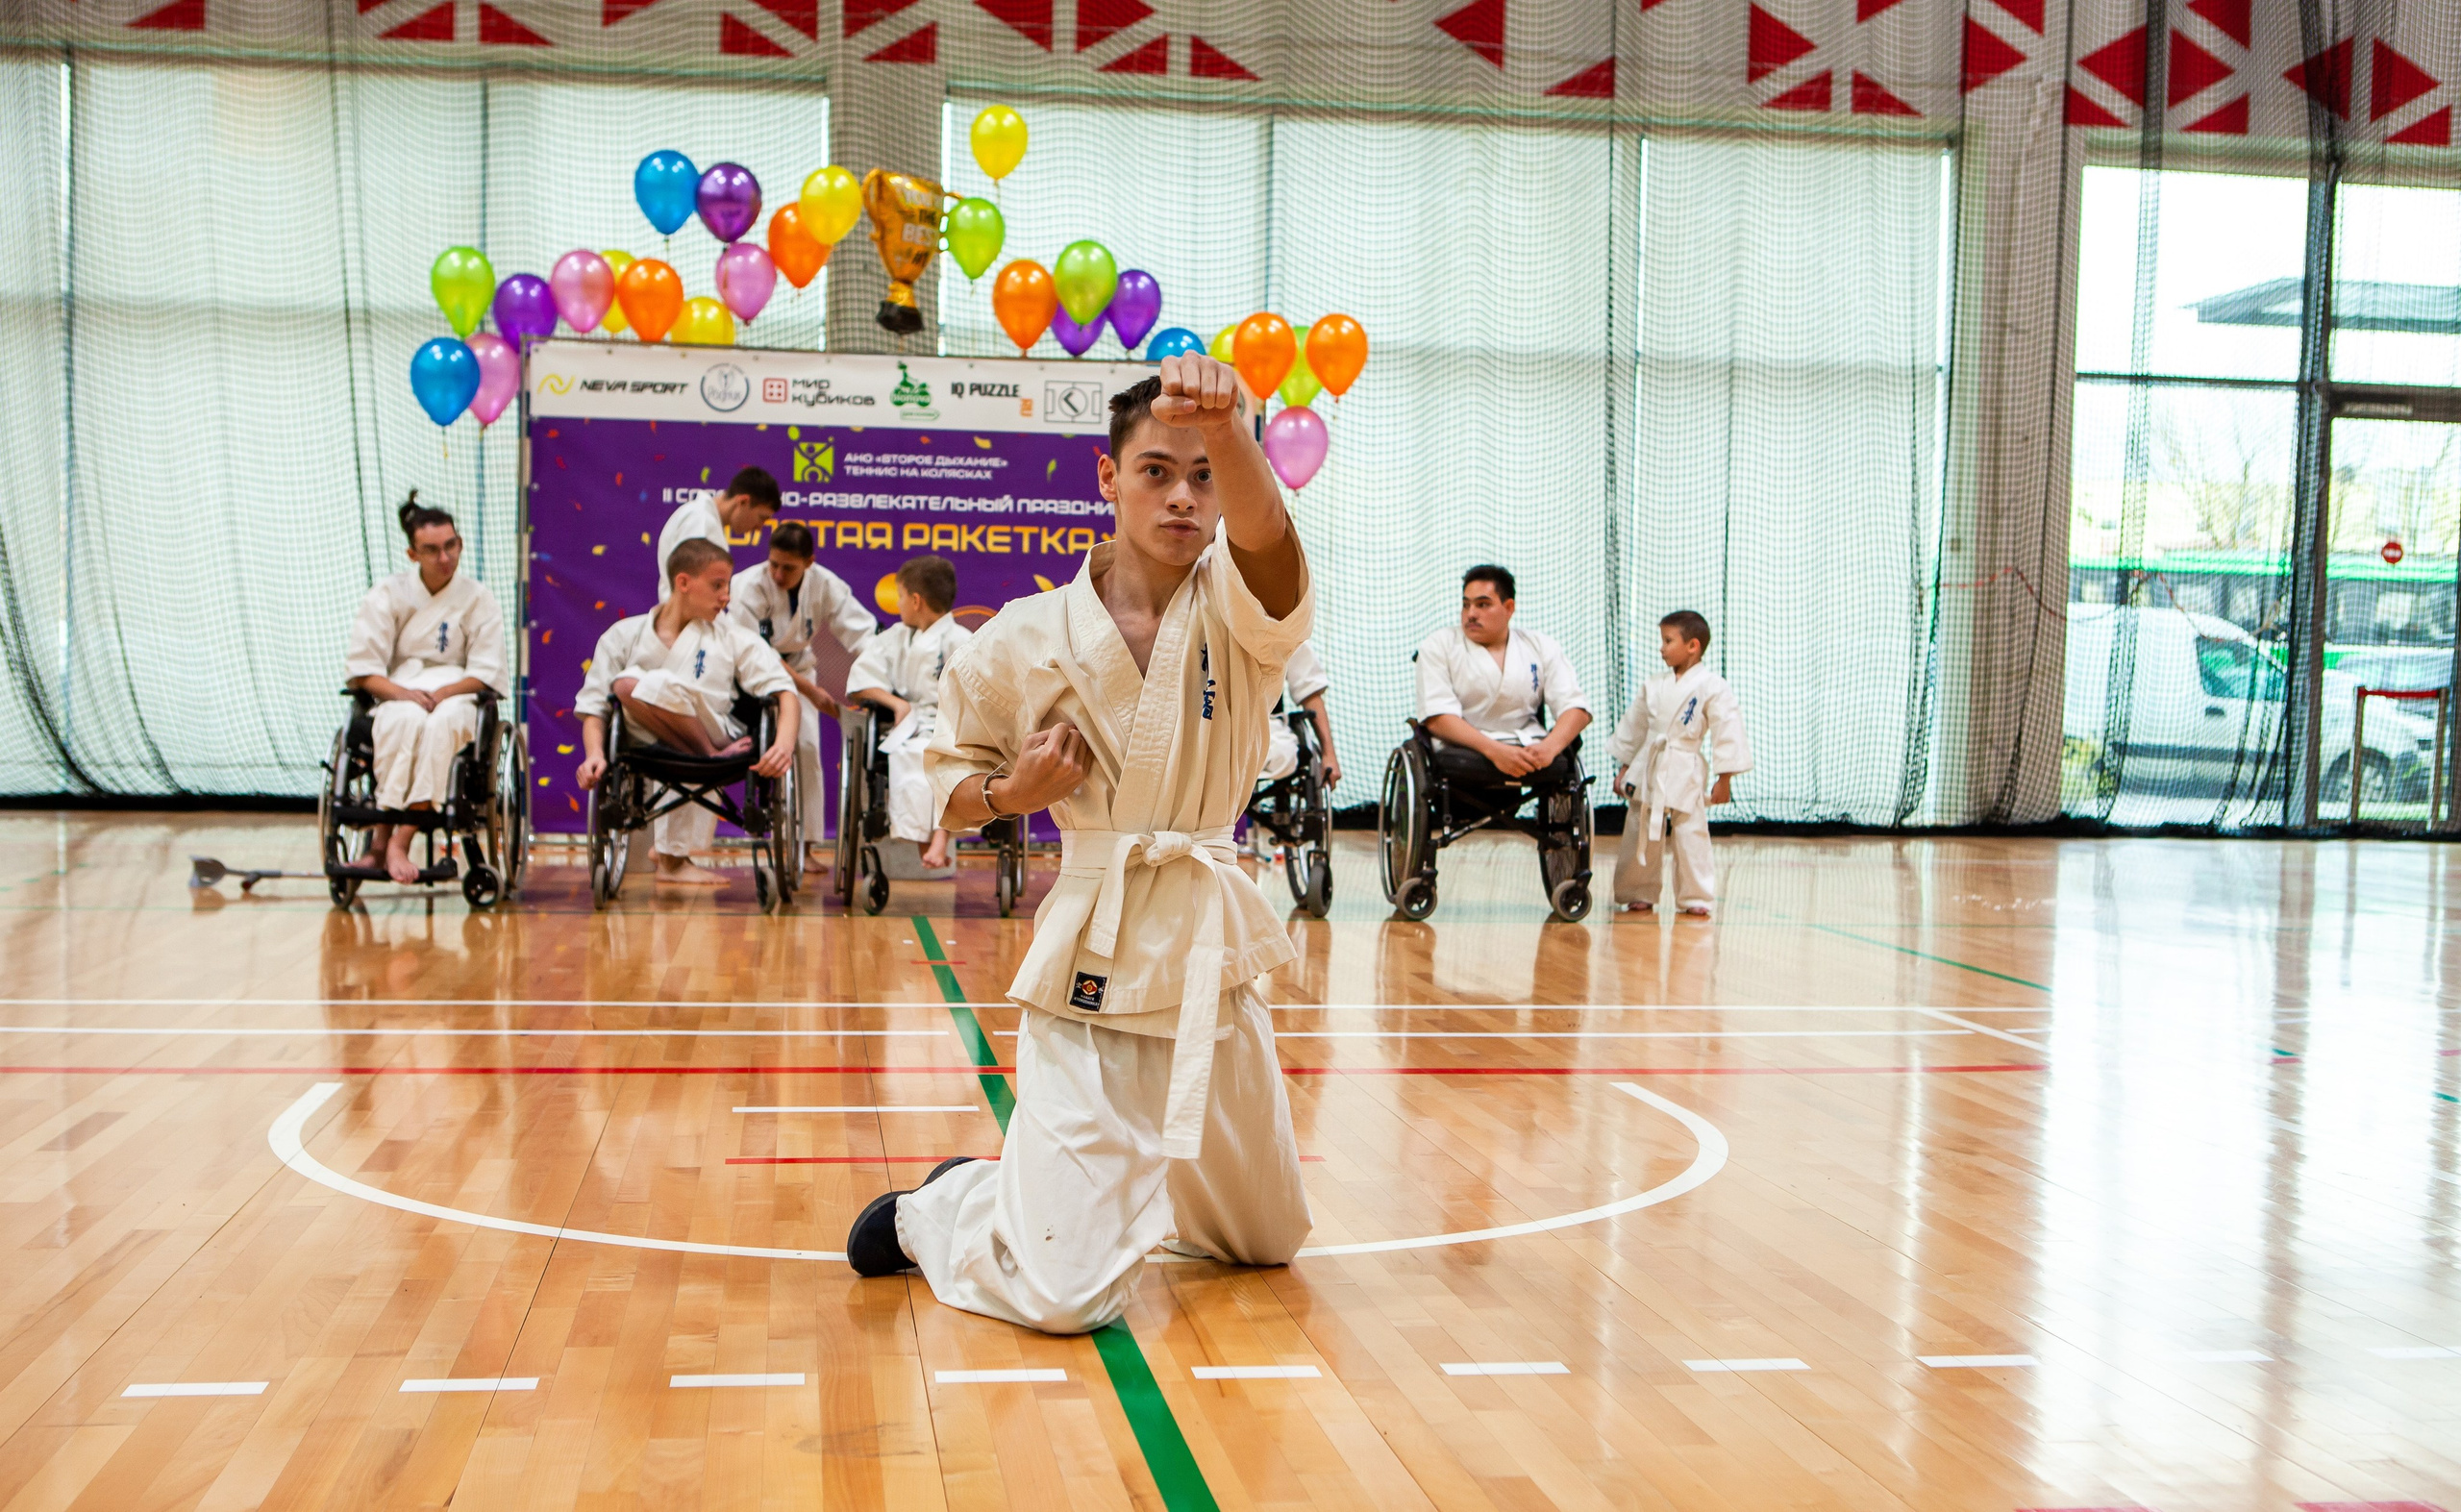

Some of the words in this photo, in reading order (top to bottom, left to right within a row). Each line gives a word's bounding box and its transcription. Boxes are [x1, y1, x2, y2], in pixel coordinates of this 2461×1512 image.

[580, 380, 628, 393] NEVA
[630, 382, 689, 394] SPORT
[950, 382, 965, 398] IQ
[969, 383, 1021, 398] PUZZLE
[844, 453, 873, 464] АНО
[844, 465, 897, 477] ТЕННИС
[900, 467, 919, 478] НА
[921, 468, 992, 480] КОЛЯСКАХ
[1017, 498, 1115, 516] ПРАЗДНИ
